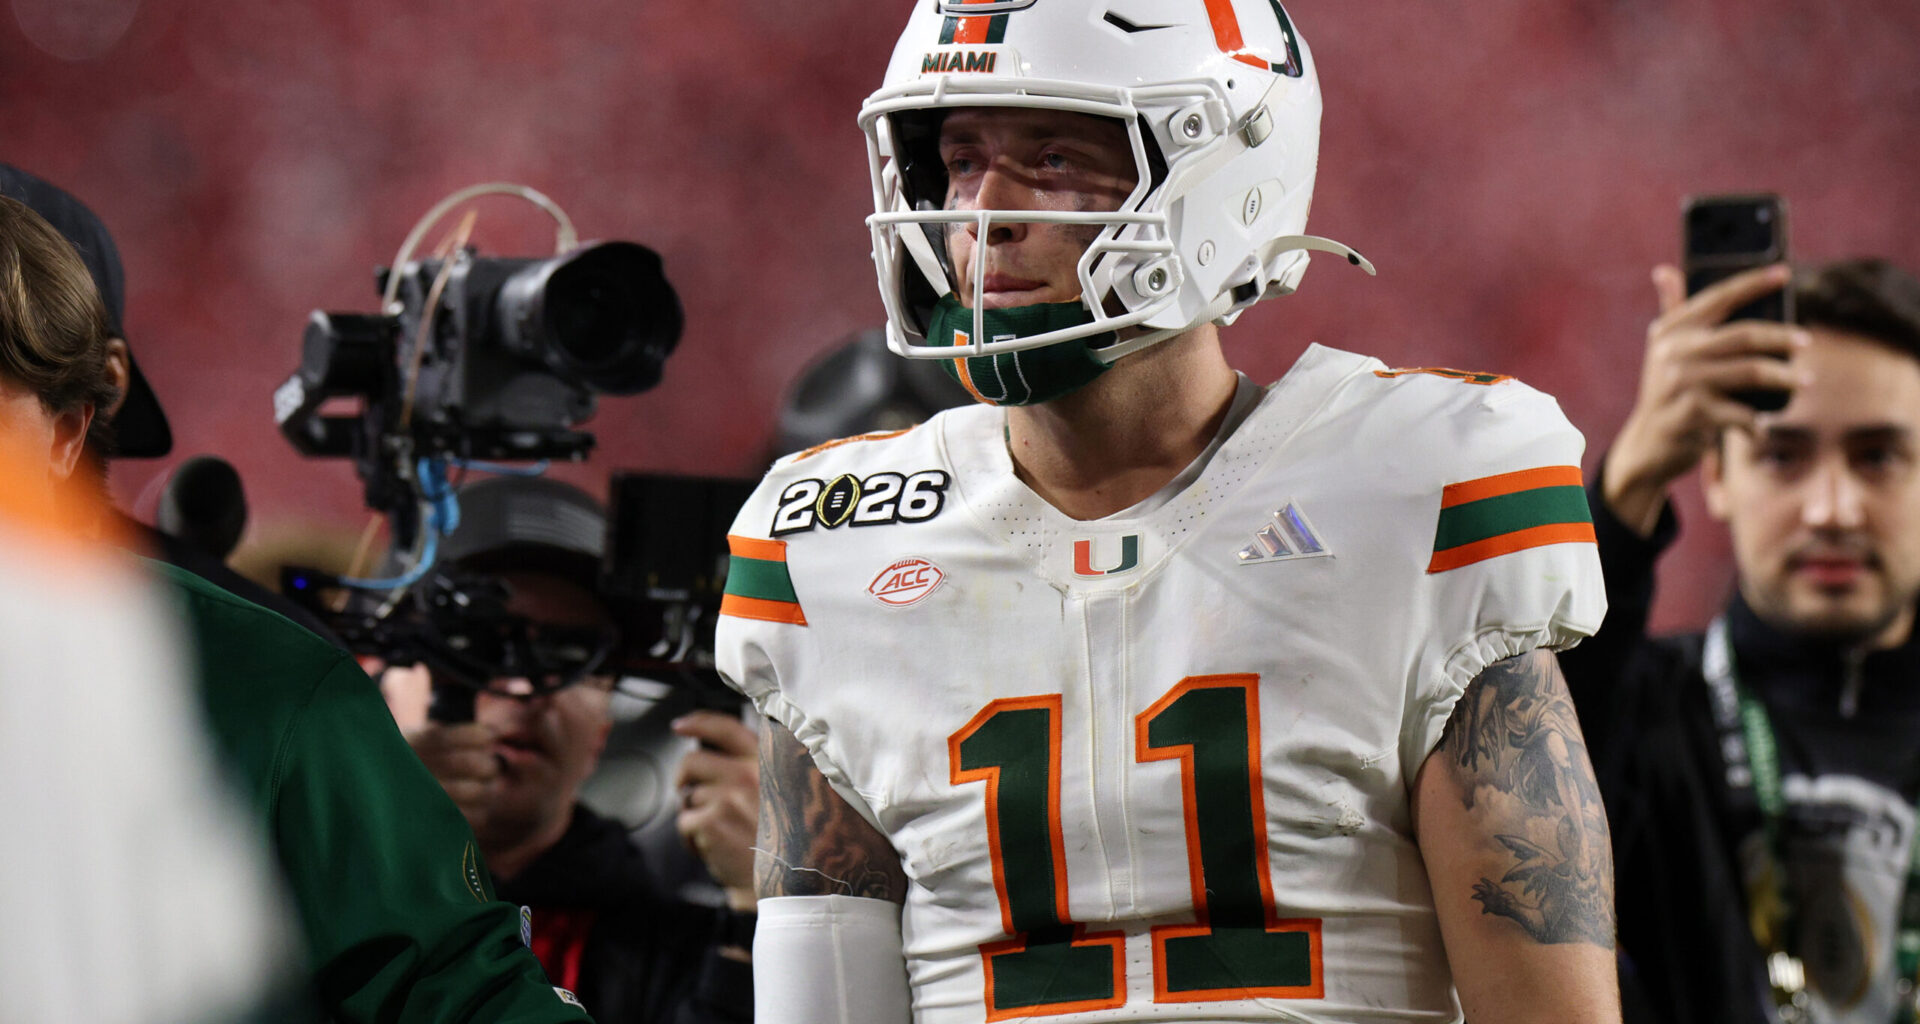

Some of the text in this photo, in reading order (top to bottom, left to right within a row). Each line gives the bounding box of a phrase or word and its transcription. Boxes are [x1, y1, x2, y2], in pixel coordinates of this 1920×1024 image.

[921, 51, 997, 74] MIAMI
[1074, 534, 1138, 576] U
[881, 566, 931, 592] ACC
[947, 672, 1324, 1023] 11
